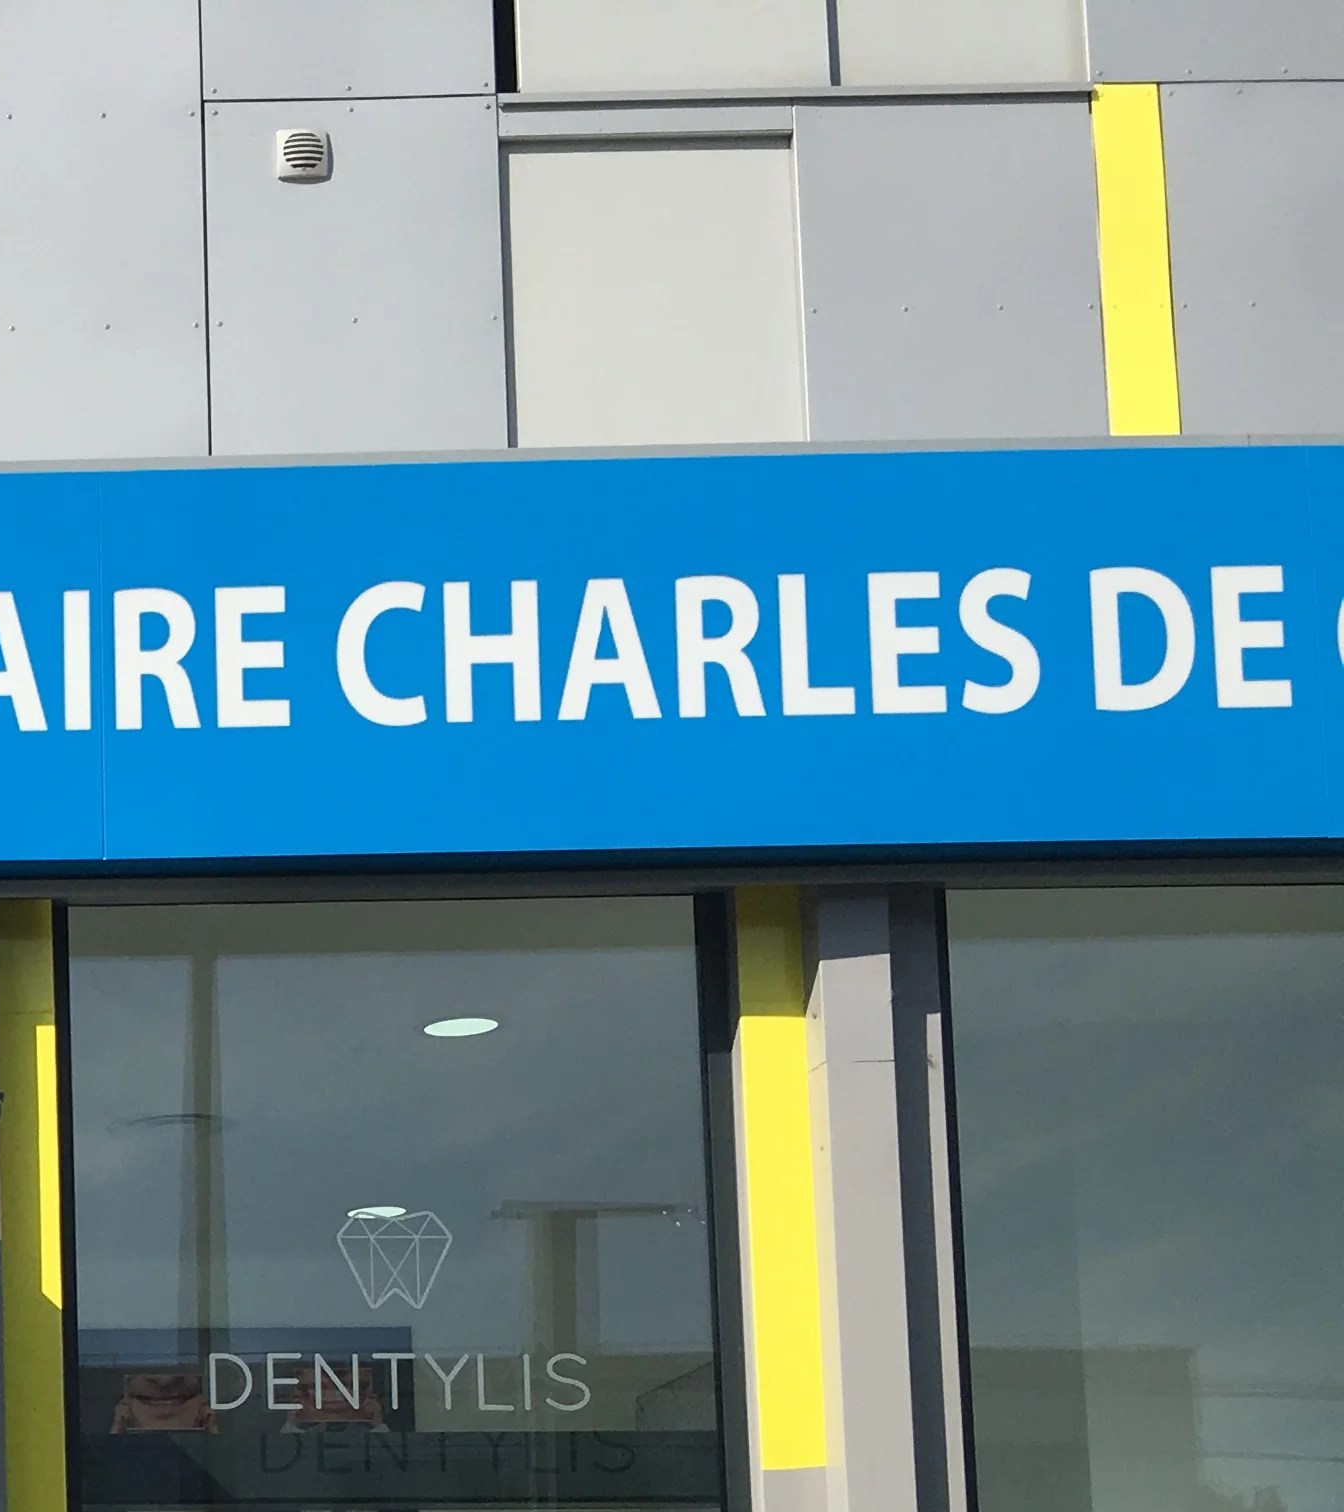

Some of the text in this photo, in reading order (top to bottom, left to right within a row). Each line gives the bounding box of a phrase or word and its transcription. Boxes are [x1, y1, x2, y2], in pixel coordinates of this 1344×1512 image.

[336, 567, 1041, 727] CHARLES
[1089, 565, 1294, 711] DE
[207, 1352, 592, 1412] DENTYLIS
